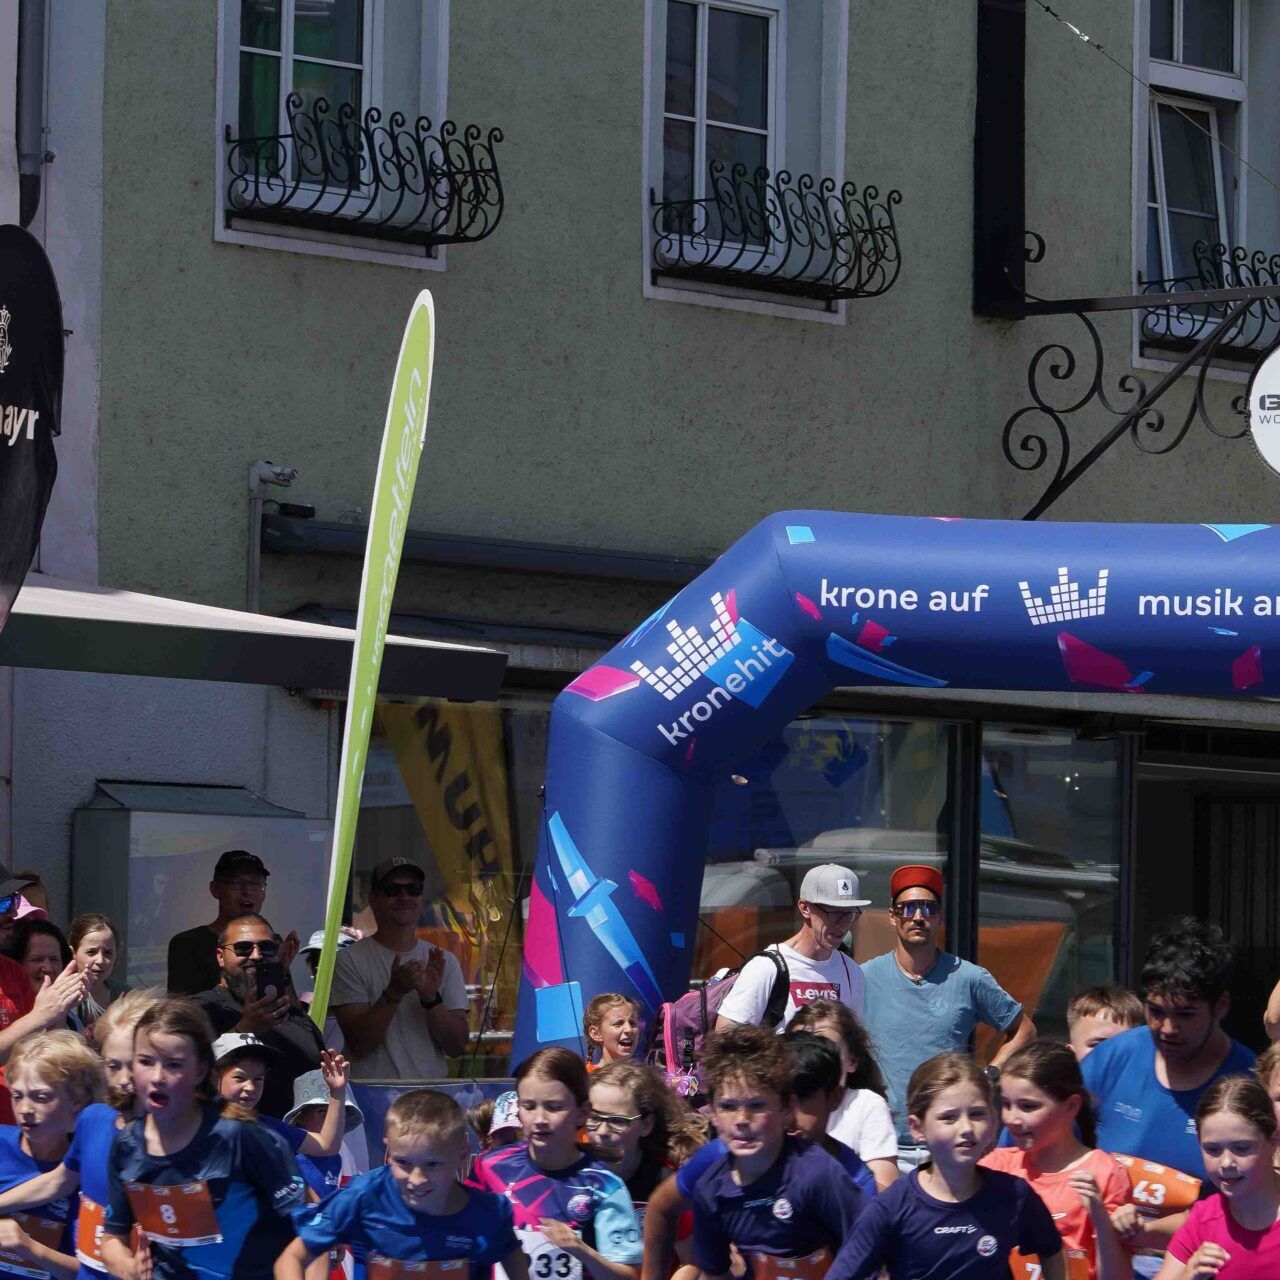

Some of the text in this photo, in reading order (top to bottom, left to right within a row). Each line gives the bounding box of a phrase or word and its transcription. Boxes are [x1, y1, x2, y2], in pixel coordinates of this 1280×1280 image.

[819, 578, 990, 613] krone auf
[1138, 588, 1244, 617] musik
[656, 636, 788, 746] kronehit
[795, 988, 838, 1001] Levi's
[1132, 1180, 1167, 1205] 43
[159, 1203, 177, 1224] 8
[934, 1225, 968, 1235] CRAFT
